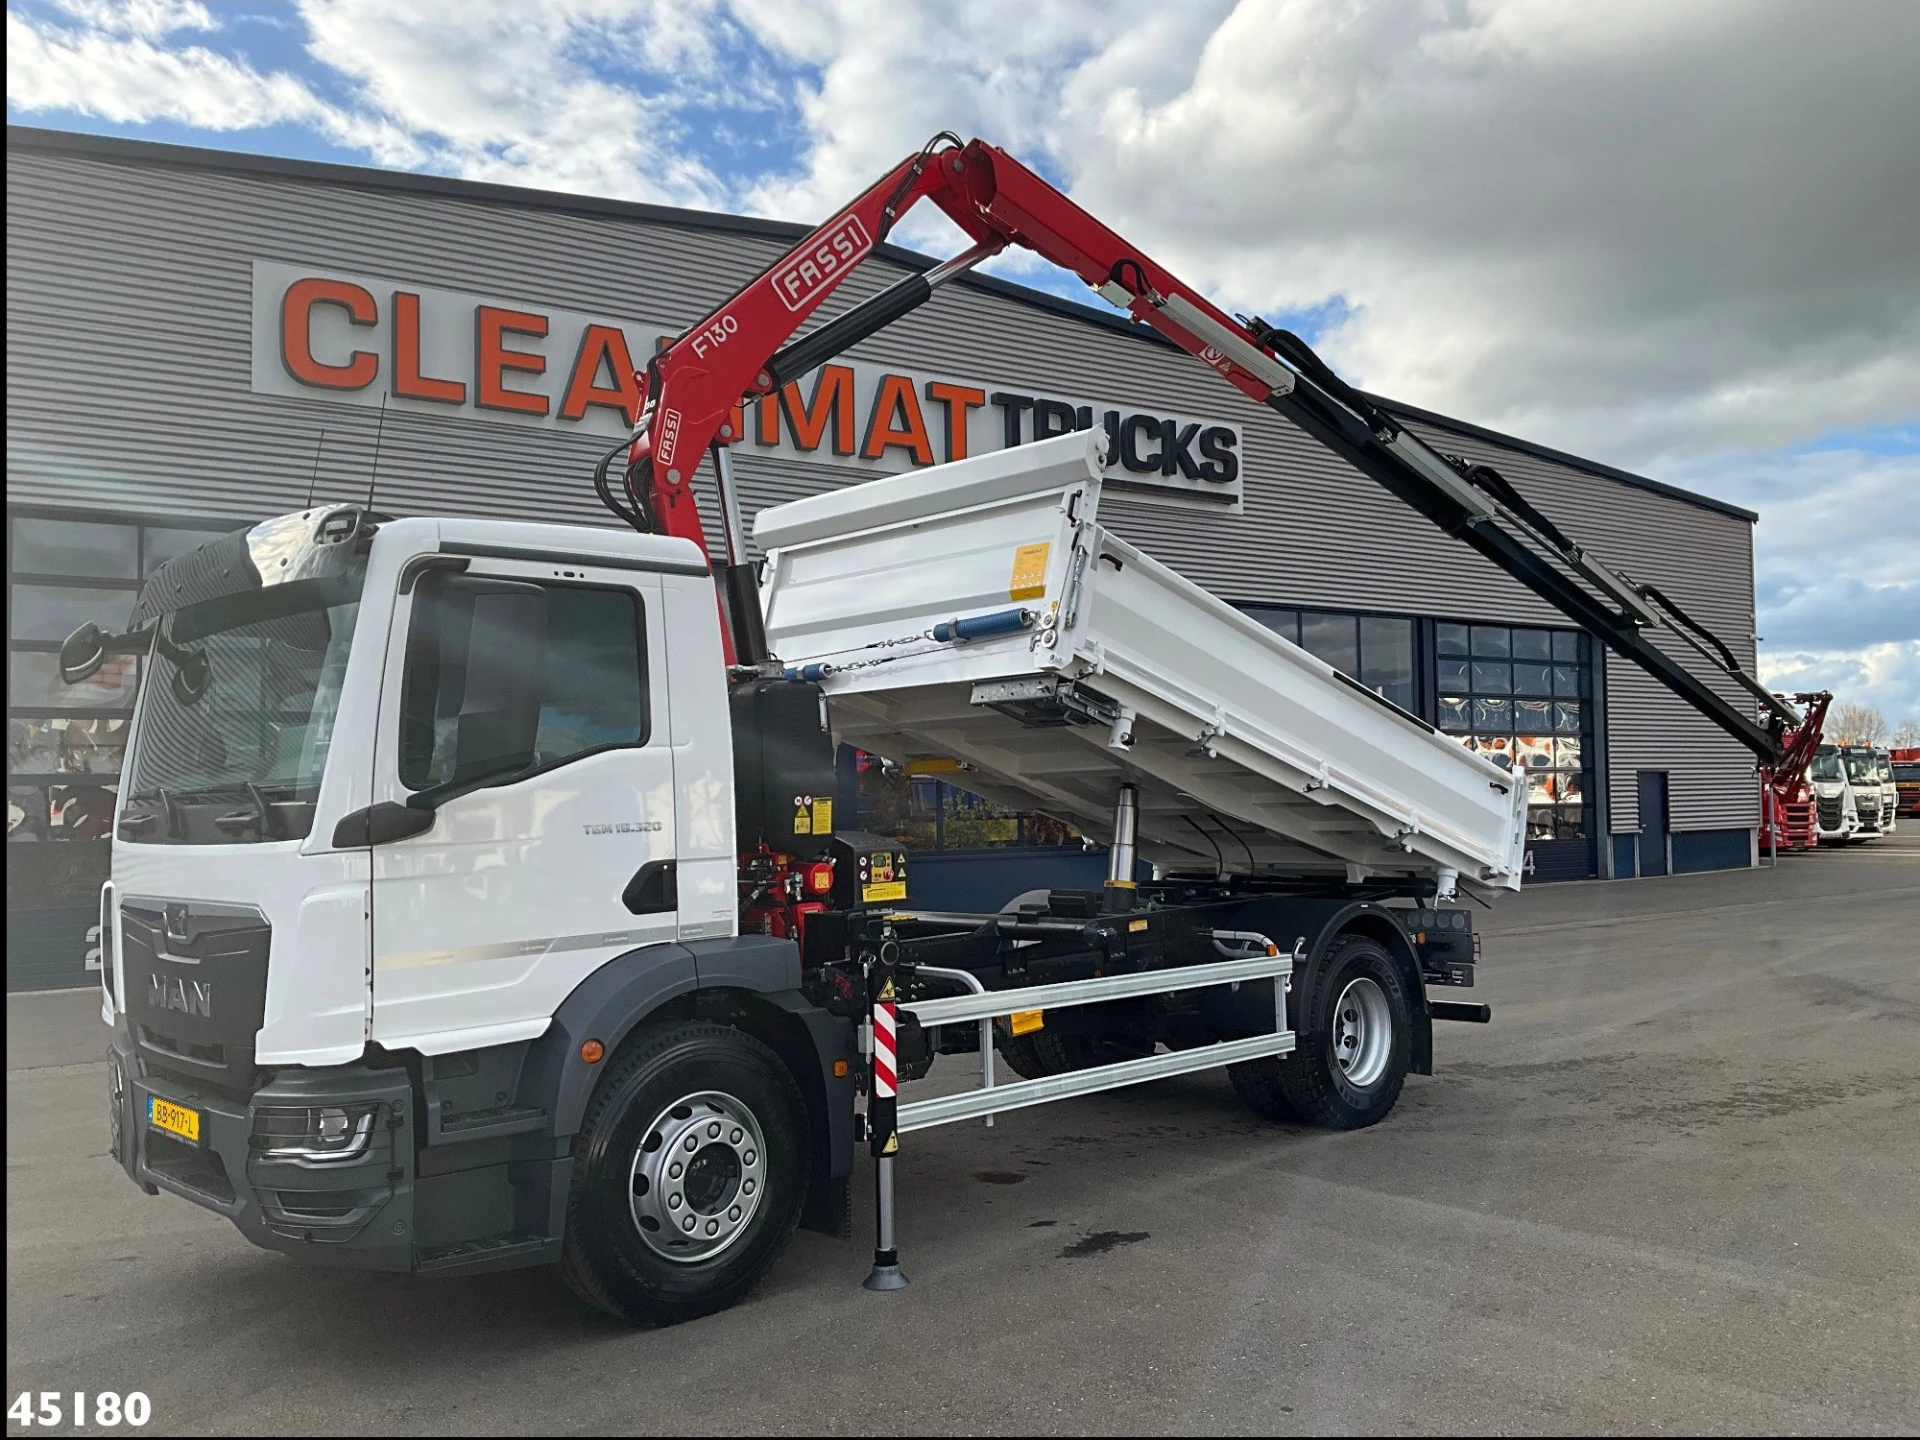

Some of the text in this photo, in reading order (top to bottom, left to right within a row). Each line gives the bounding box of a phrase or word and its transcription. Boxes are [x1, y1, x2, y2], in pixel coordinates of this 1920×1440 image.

[783, 226, 862, 299] FASSI
[691, 314, 738, 359] F130
[280, 277, 985, 465] CLEAMAT
[660, 413, 678, 461] FASSI
[582, 821, 662, 835] TGM 18.320
[1522, 850, 1536, 876] 4
[149, 973, 211, 1017] MAN
